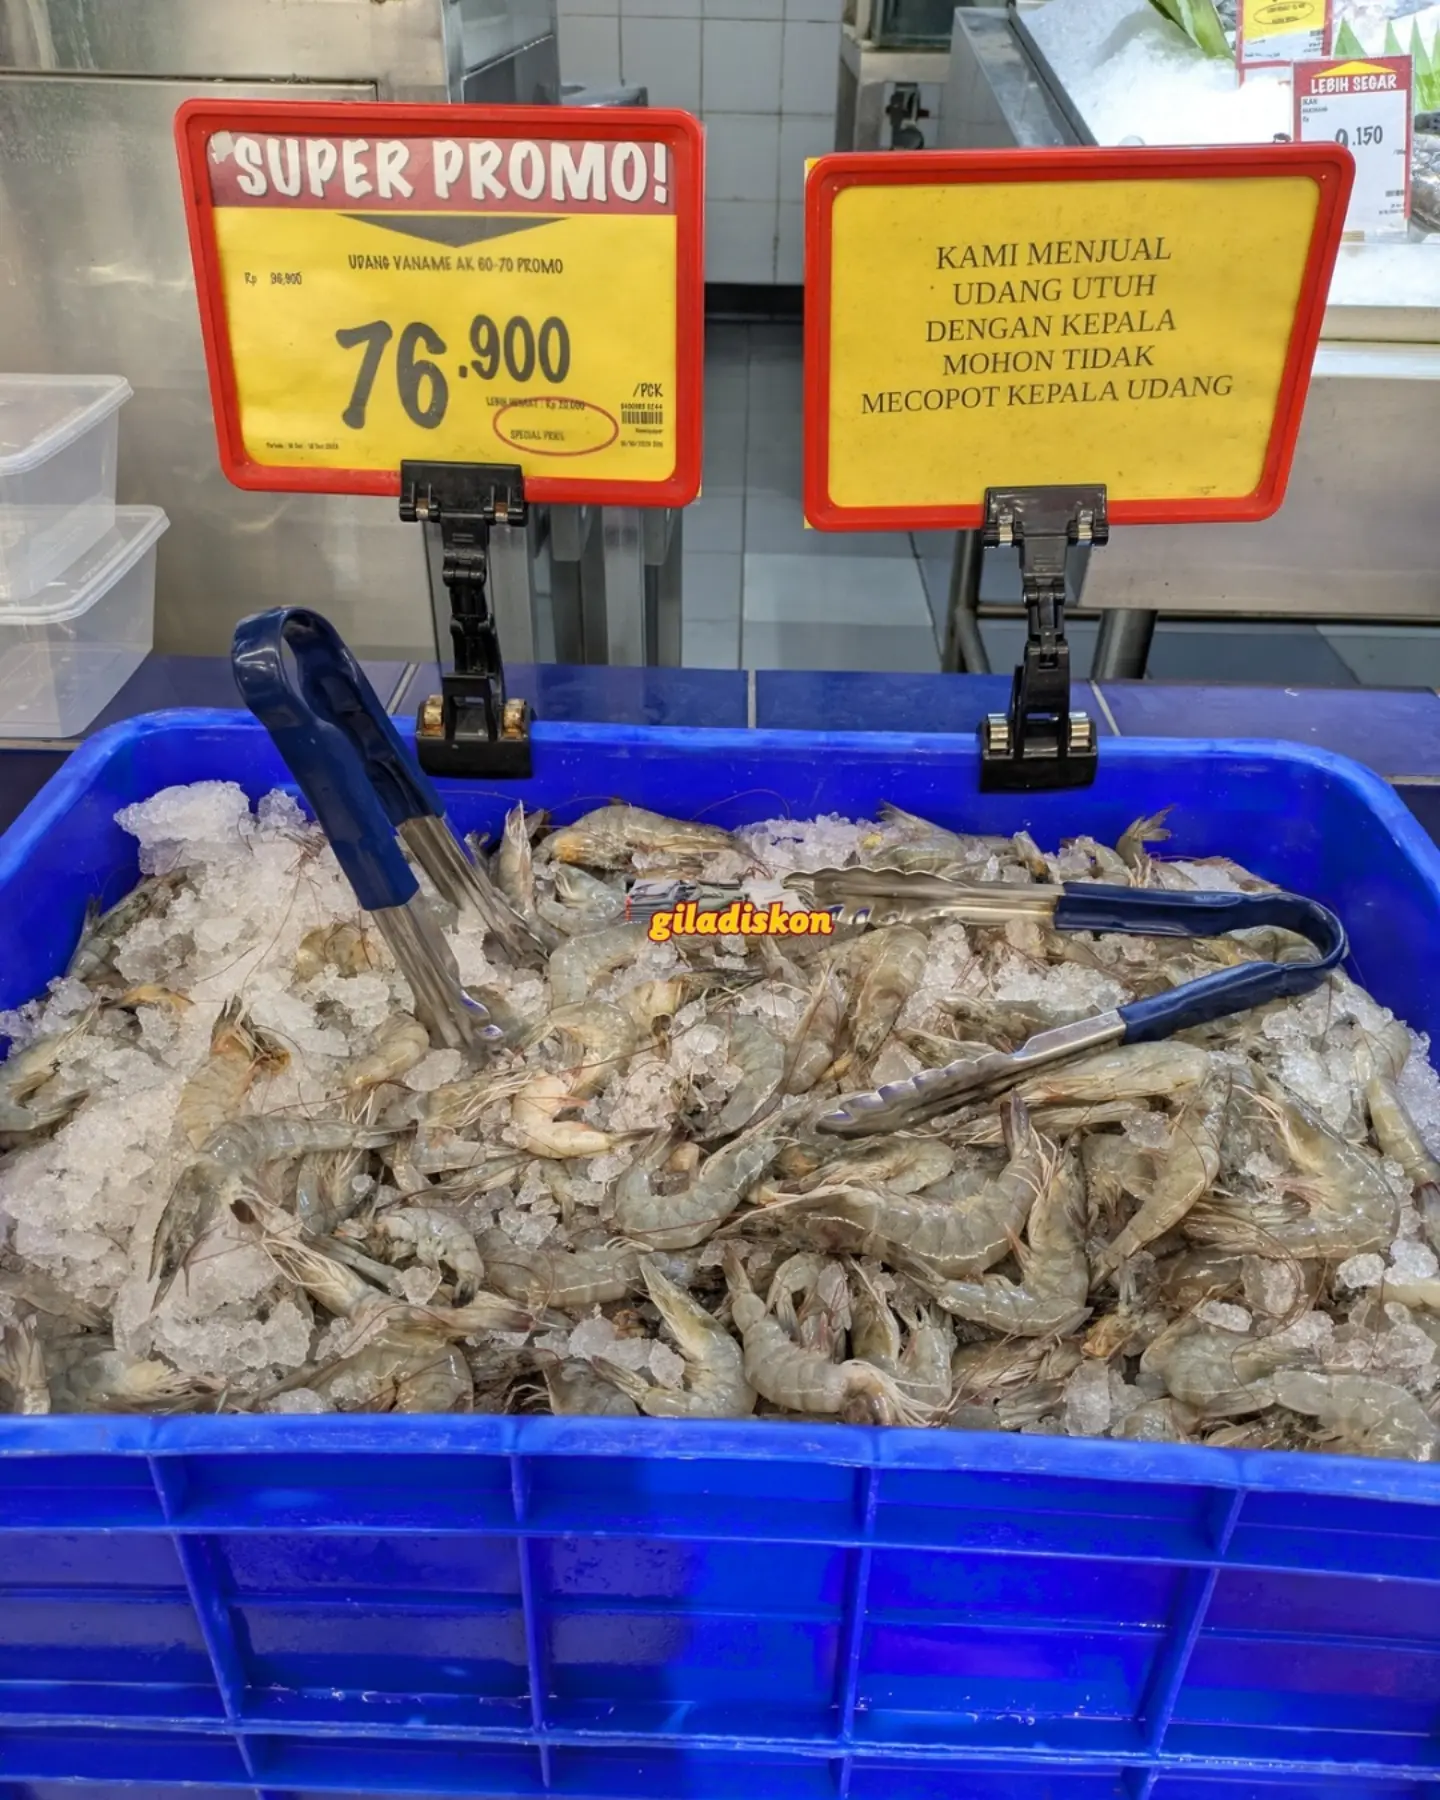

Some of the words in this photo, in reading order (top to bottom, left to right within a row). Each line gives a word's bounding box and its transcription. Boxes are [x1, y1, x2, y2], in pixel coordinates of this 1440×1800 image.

[1311, 76, 1348, 94] LEBIH
[1353, 74, 1397, 92] SEGAR
[234, 136, 413, 199] SUPER
[433, 139, 667, 204] PROMO!
[348, 254, 390, 270] UDANG
[393, 256, 451, 271] VANAME
[456, 256, 475, 271] AK
[477, 257, 513, 272] 60-70
[517, 258, 564, 274] PROMO
[936, 243, 1019, 270] KAMI
[1027, 237, 1171, 266] MENJUAL
[244, 272, 257, 286] Rp
[953, 278, 1062, 306] UDANG
[1073, 274, 1157, 300] UTUH
[925, 315, 1053, 343] DENGAN
[1061, 309, 1177, 337] KEPALA
[942, 349, 1055, 377] MOHON
[1063, 345, 1155, 371] TIDAK
[632, 382, 664, 398] /PCK
[861, 385, 1001, 415] MECOPOT
[1007, 380, 1119, 407] KEPALA
[1128, 375, 1233, 401] UDANG
